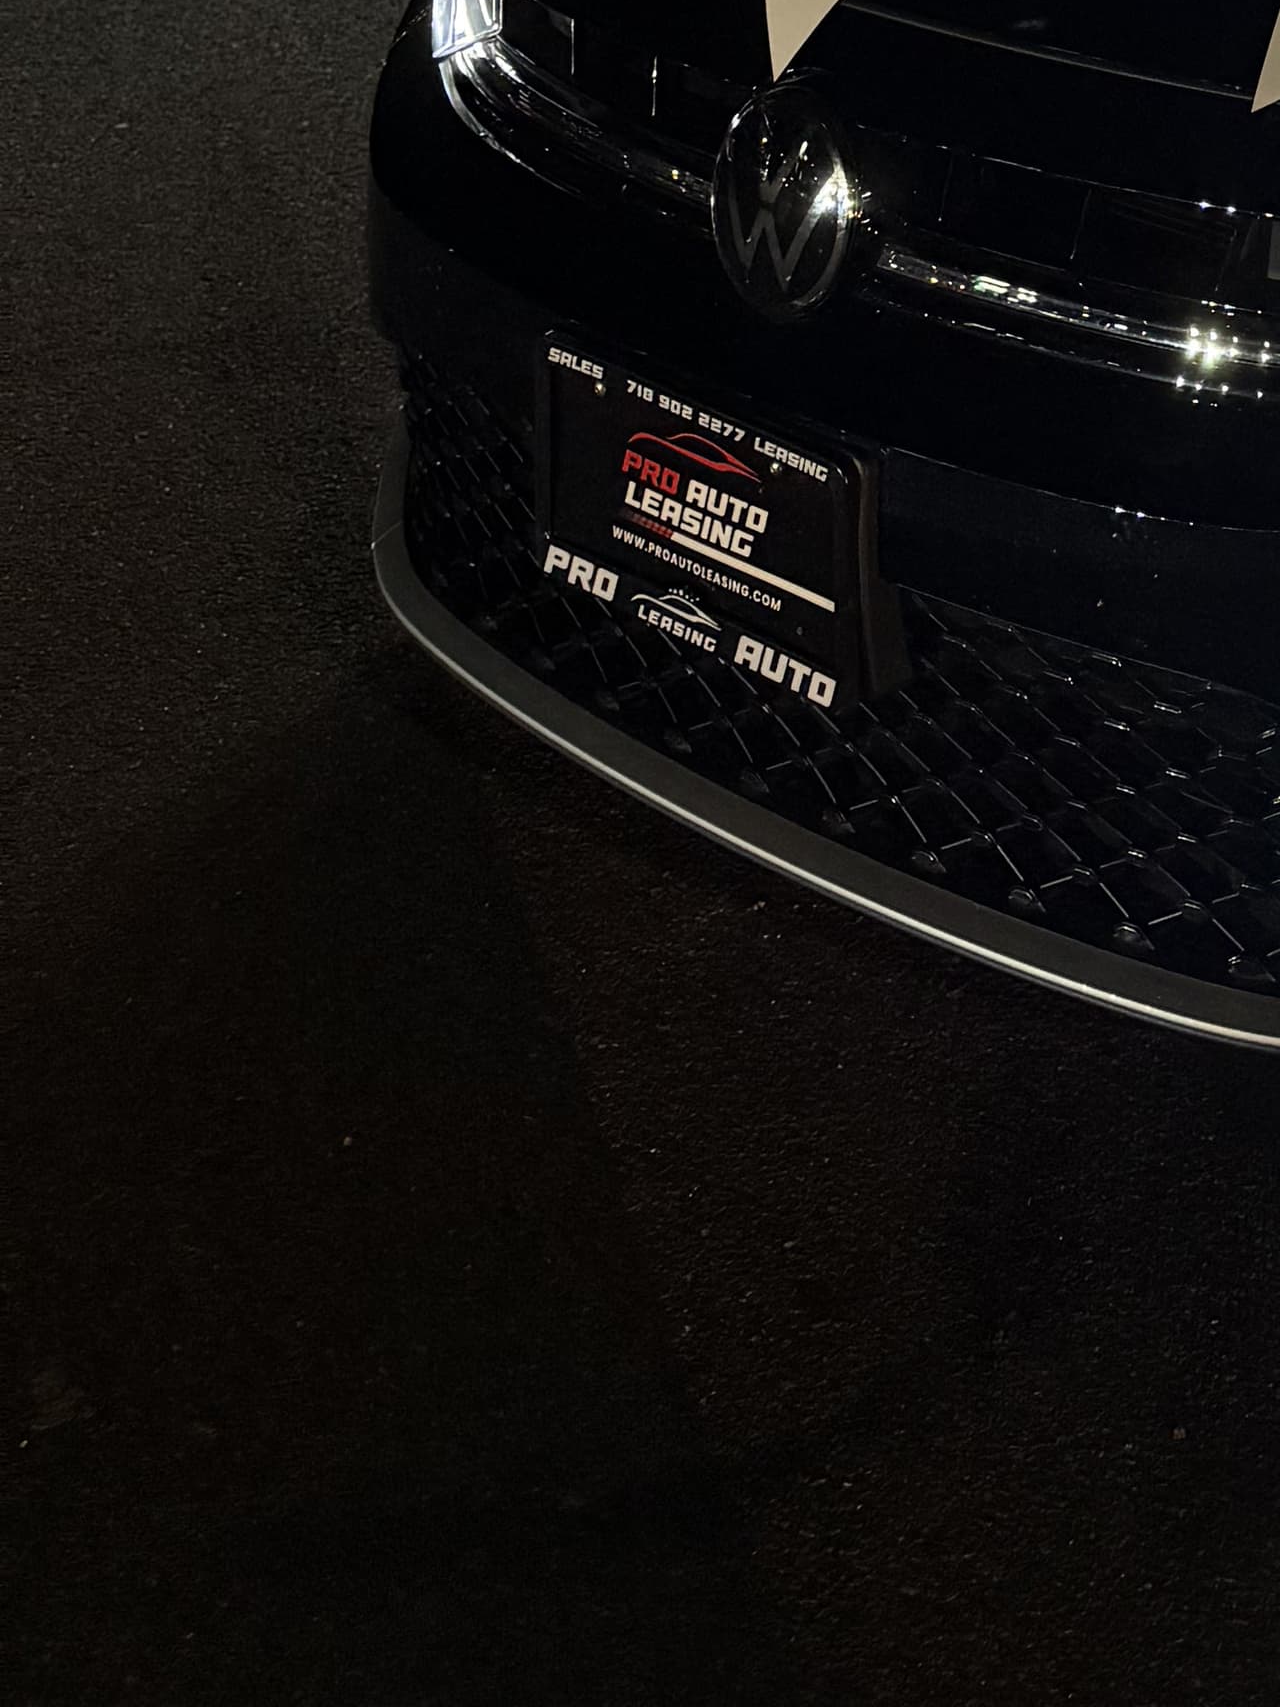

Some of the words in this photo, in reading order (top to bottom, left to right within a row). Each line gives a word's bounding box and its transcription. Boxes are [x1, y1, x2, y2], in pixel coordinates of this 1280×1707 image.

[547, 345, 604, 380] SALES
[626, 378, 655, 403] 718
[657, 393, 694, 421] 902
[697, 410, 747, 443] 2277
[753, 435, 830, 483] LEASING
[620, 448, 681, 497] PRO
[684, 478, 769, 535] AUTO
[623, 479, 756, 559] LEASING
[543, 543, 620, 603] PRO
[611, 524, 783, 613] WWW.PROAUTOLEASING.COM
[636, 603, 718, 654] LEASING
[733, 634, 838, 708] AUTO
